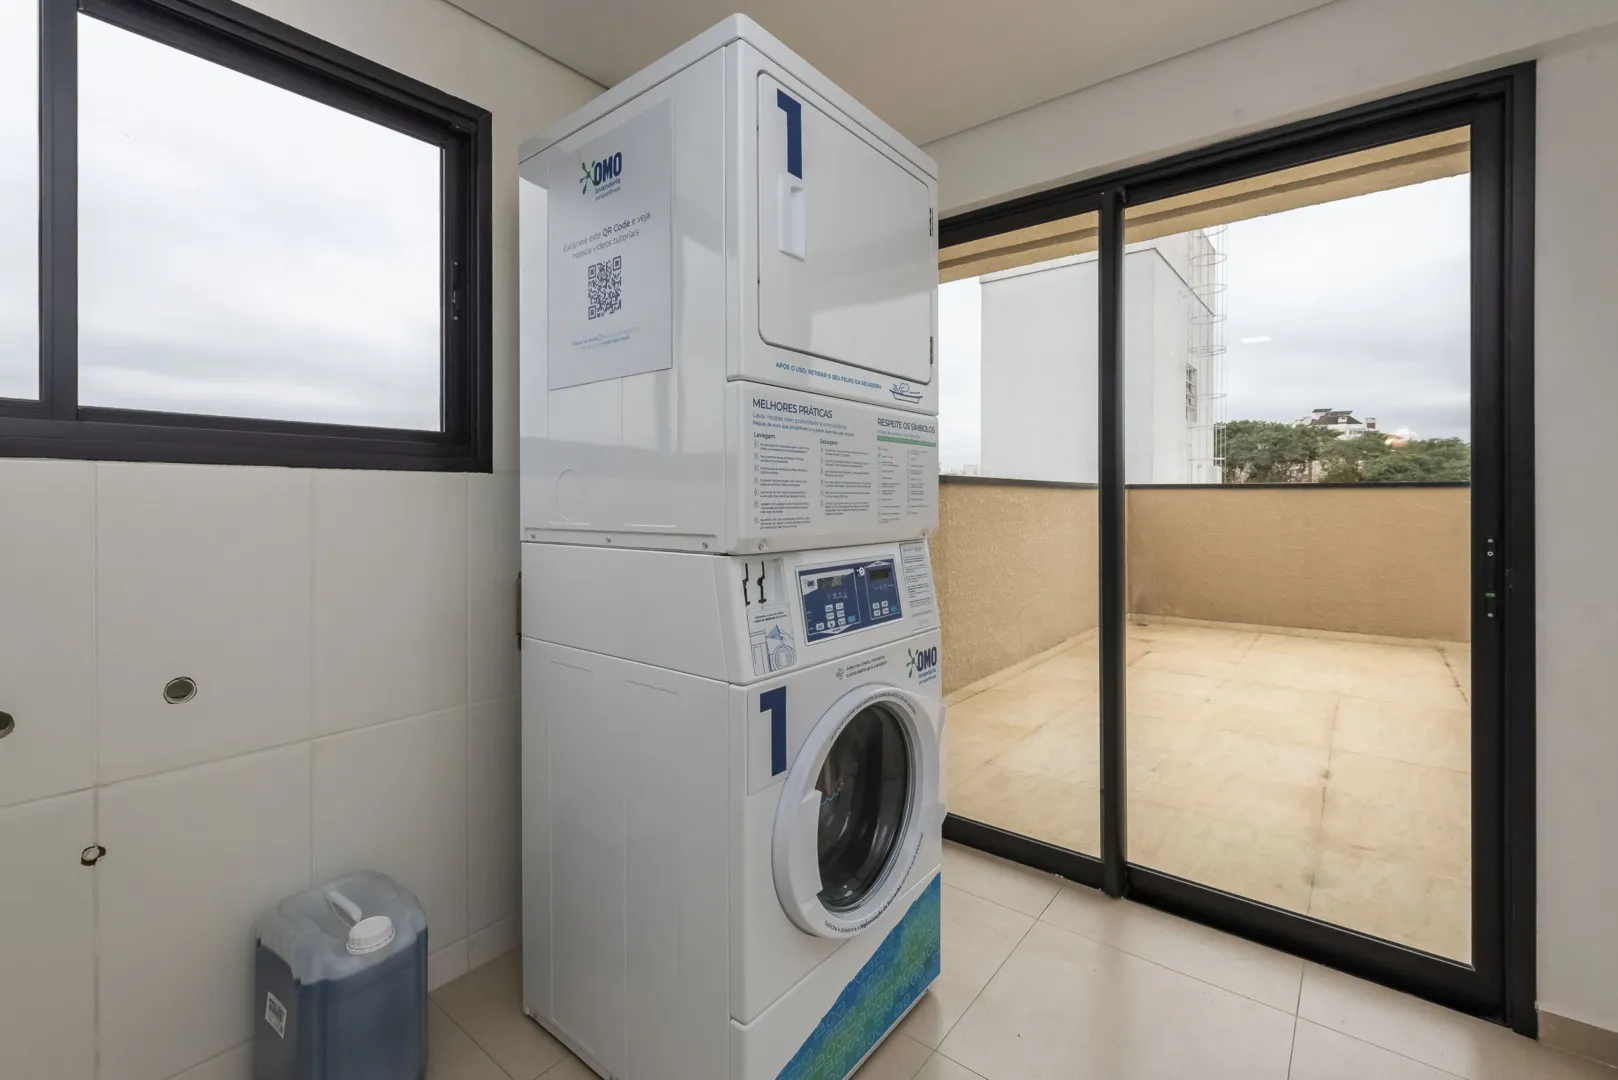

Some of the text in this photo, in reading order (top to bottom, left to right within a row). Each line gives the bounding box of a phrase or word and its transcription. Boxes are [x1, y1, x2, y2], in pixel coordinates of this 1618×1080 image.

[777, 88, 802, 180] 1
[593, 151, 622, 186] OMO
[588, 231, 602, 242] este
[602, 226, 612, 237] QR
[613, 219, 631, 233] Code
[637, 211, 651, 223] veja
[613, 229, 640, 246] tutoriais
[808, 369, 827, 378] RETIRAR
[832, 373, 841, 381] SEU
[752, 398, 833, 419] MELHORES PRÁTICAS
[877, 417, 936, 434] RESPEITE OS SÍMBOLOS
[917, 646, 937, 672] OMO
[760, 685, 787, 777] 1
